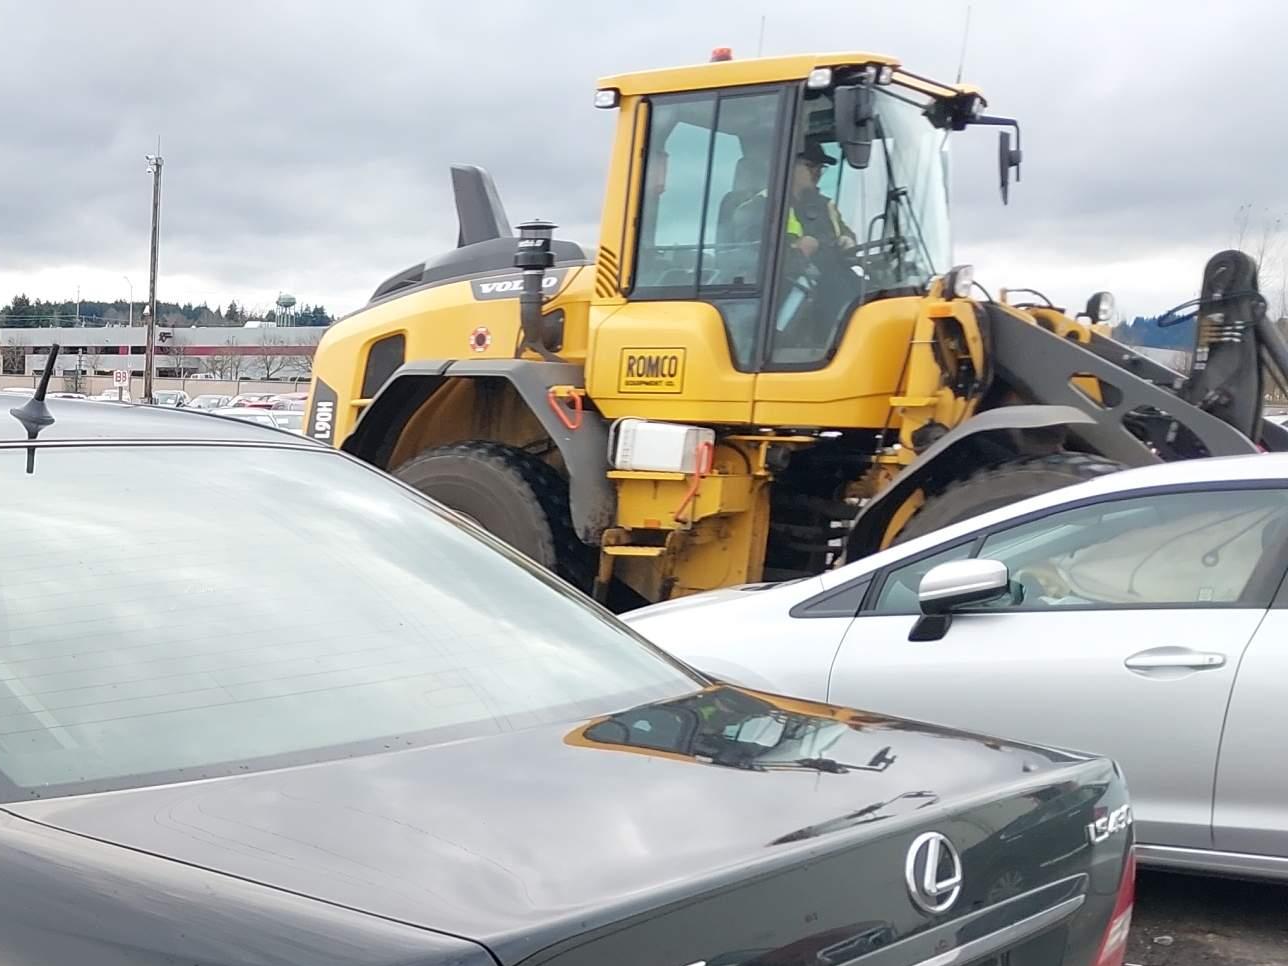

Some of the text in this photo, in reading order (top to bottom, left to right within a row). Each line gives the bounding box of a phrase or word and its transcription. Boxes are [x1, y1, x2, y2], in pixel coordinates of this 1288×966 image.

[479, 277, 558, 294] VOLO
[626, 355, 678, 378] ROMCO
[314, 401, 334, 439] L90H
